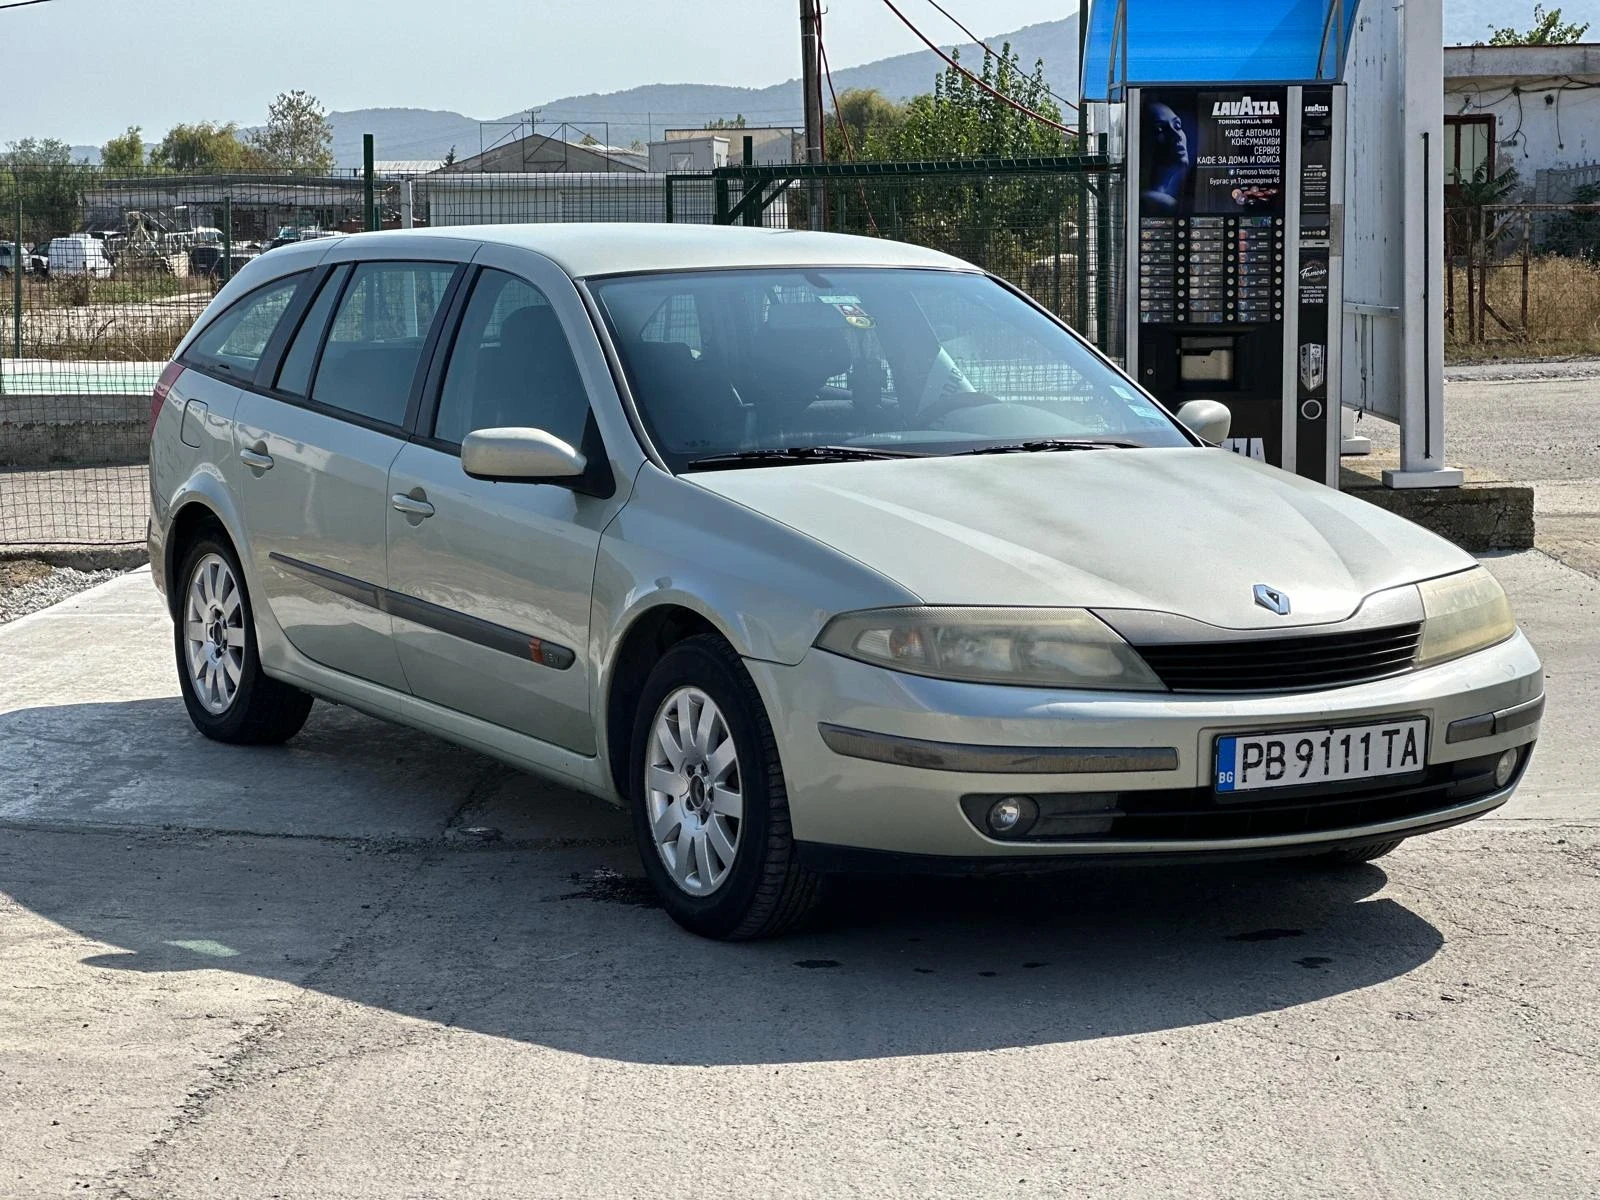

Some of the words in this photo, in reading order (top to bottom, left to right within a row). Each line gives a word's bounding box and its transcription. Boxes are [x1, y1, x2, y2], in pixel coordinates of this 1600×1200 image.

[1212, 96, 1280, 115] LAVAZZA
[1225, 129, 1244, 137] КАФЕ
[1245, 128, 1280, 136] АВТОМАТИ
[1231, 137, 1280, 145] КОНСУМАТИВИ
[1254, 146, 1280, 154] СЕРВИЗ
[1197, 156, 1217, 164] КАФЕ
[1218, 156, 1227, 164] ЗА
[1228, 156, 1249, 165] ДОМА
[1256, 155, 1280, 163] ОФИСА
[1258, 168, 1280, 176] Vending
[1299, 266, 1327, 280] Famoso
[1241, 740, 1286, 783] PB
[1295, 732, 1371, 778] 9111
[1382, 727, 1418, 769] TA
[1218, 771, 1233, 784] BG
